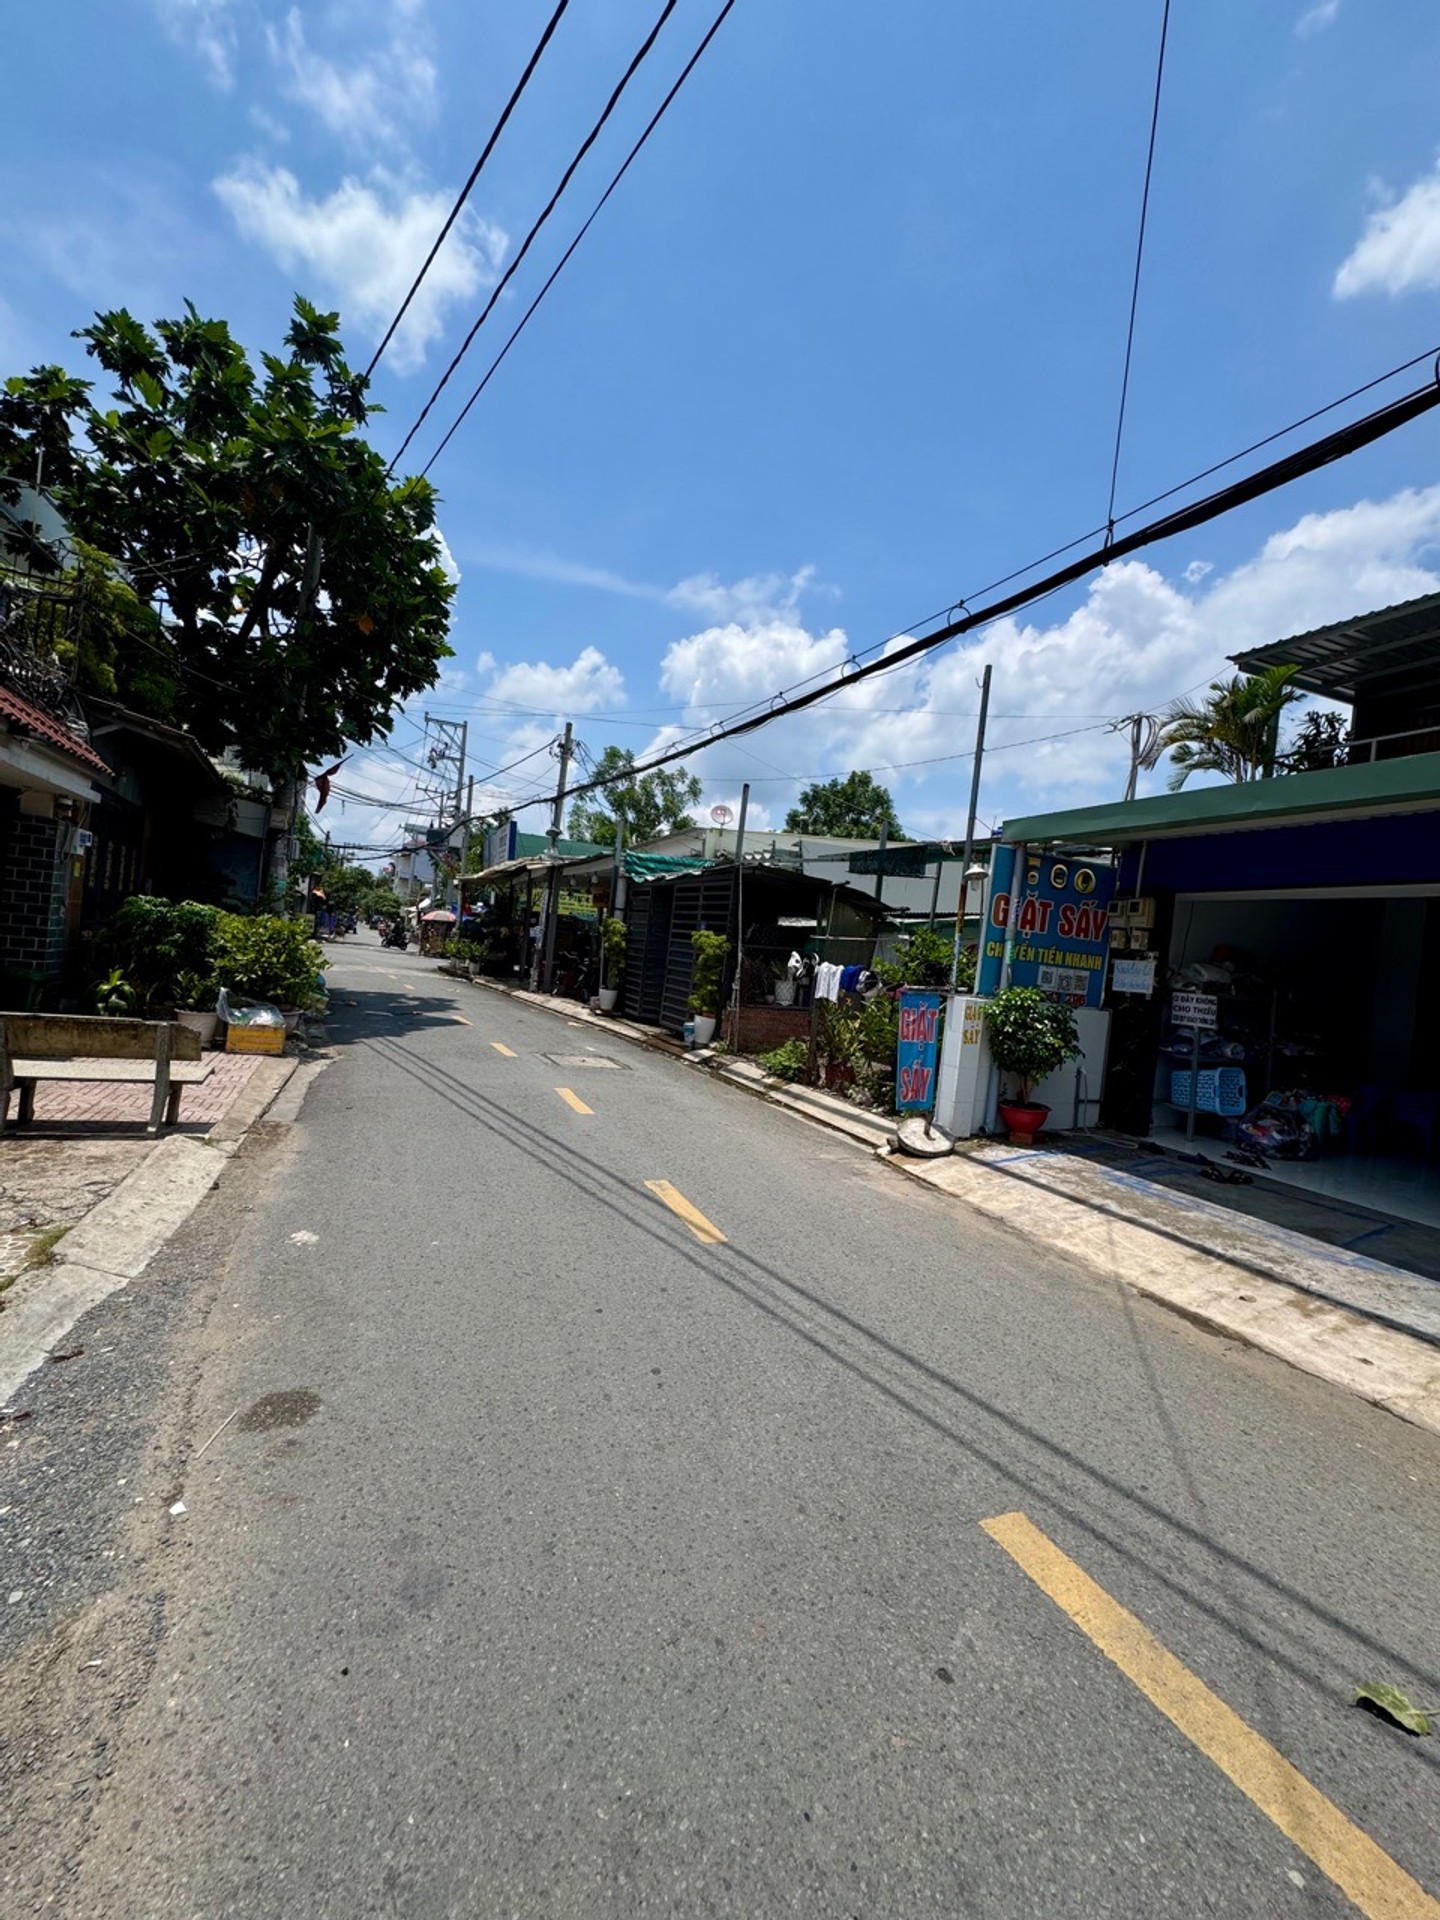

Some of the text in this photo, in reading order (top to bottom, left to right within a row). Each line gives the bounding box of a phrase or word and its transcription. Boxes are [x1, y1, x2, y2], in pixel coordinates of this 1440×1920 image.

[992, 889, 1108, 941] GẶT SẤY
[1065, 952, 1102, 970] NHANH
[901, 1001, 938, 1050] GIẶT
[900, 1056, 932, 1102] SẤY
